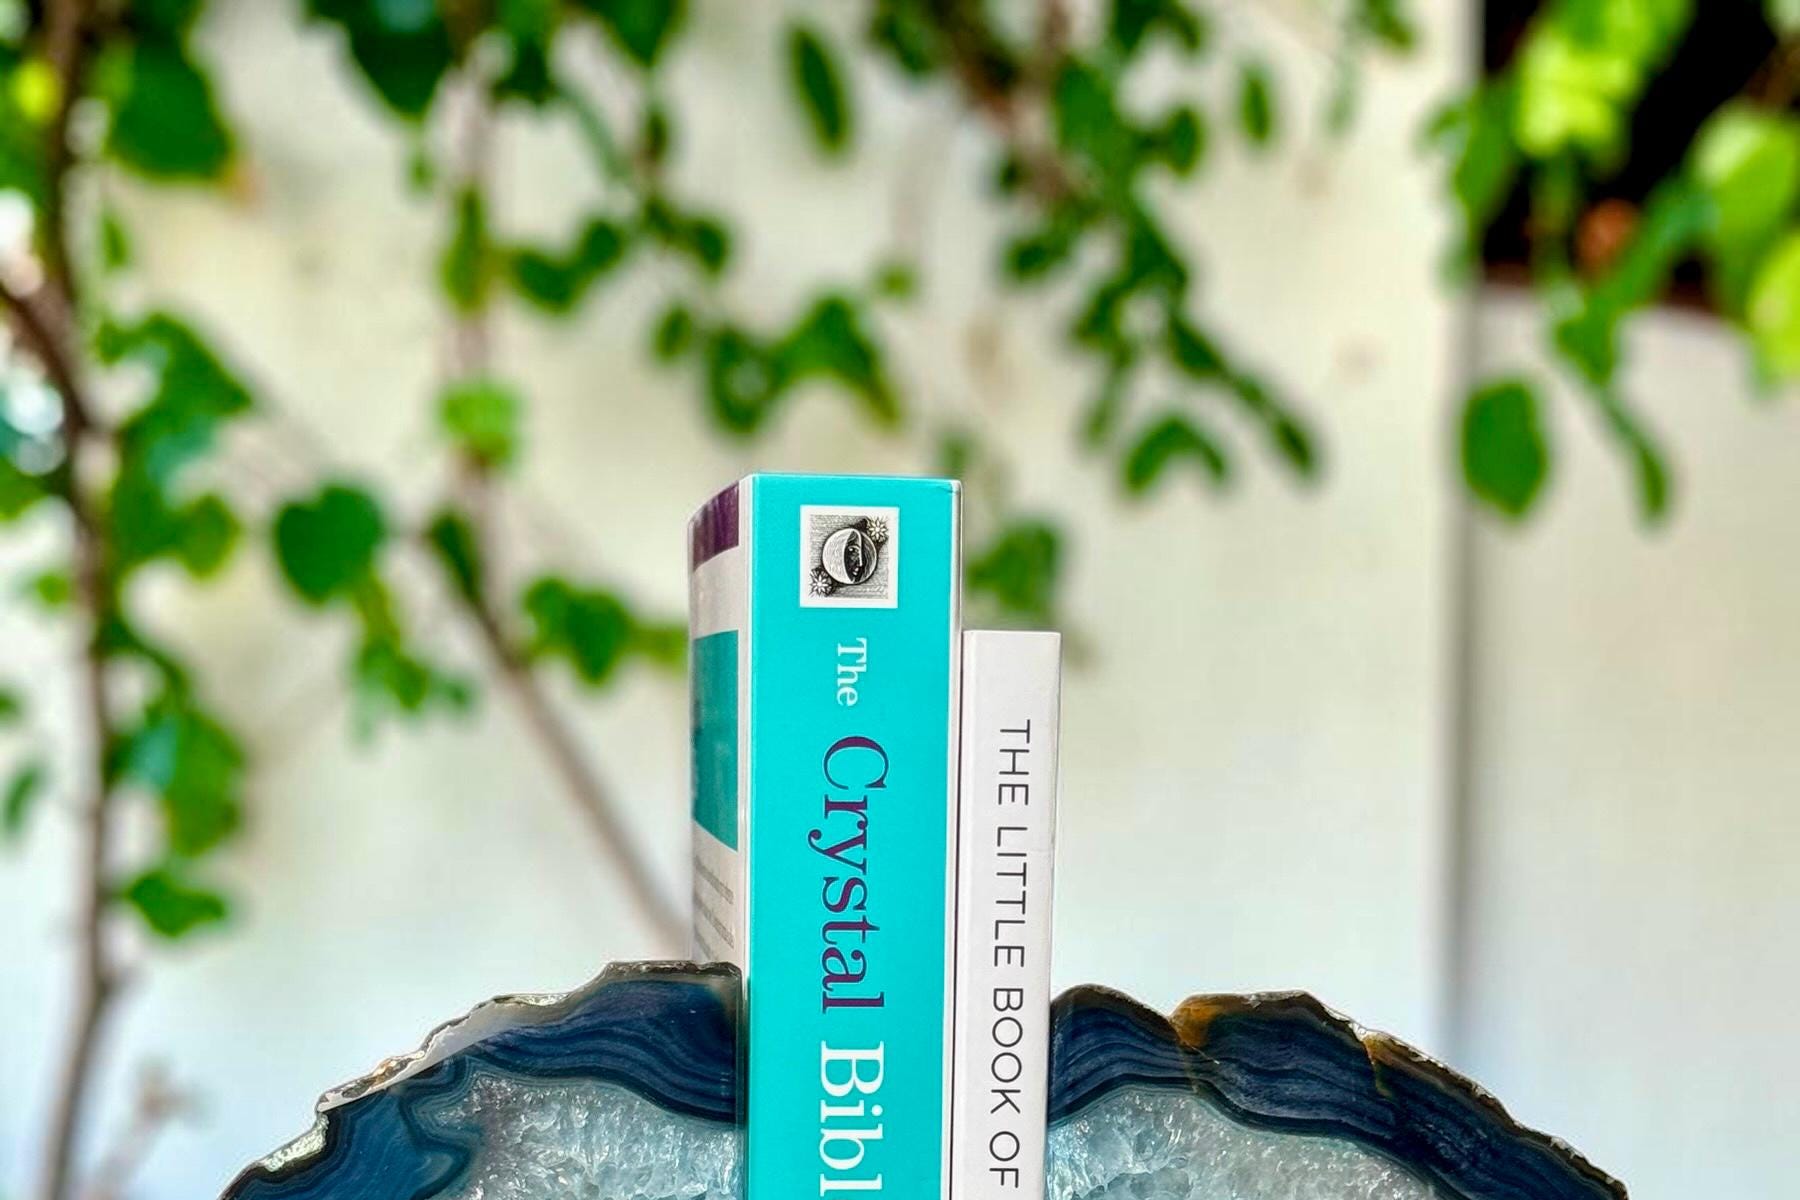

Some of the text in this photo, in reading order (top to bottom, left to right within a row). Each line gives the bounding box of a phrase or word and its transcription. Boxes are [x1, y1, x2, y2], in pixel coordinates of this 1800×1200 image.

[837, 638, 867, 706] The
[998, 719, 1030, 805] THE
[807, 736, 888, 1013] Crystal
[994, 827, 1028, 967] LITTLE
[991, 988, 1023, 1114] BOOK
[989, 1131, 1020, 1188] OF
